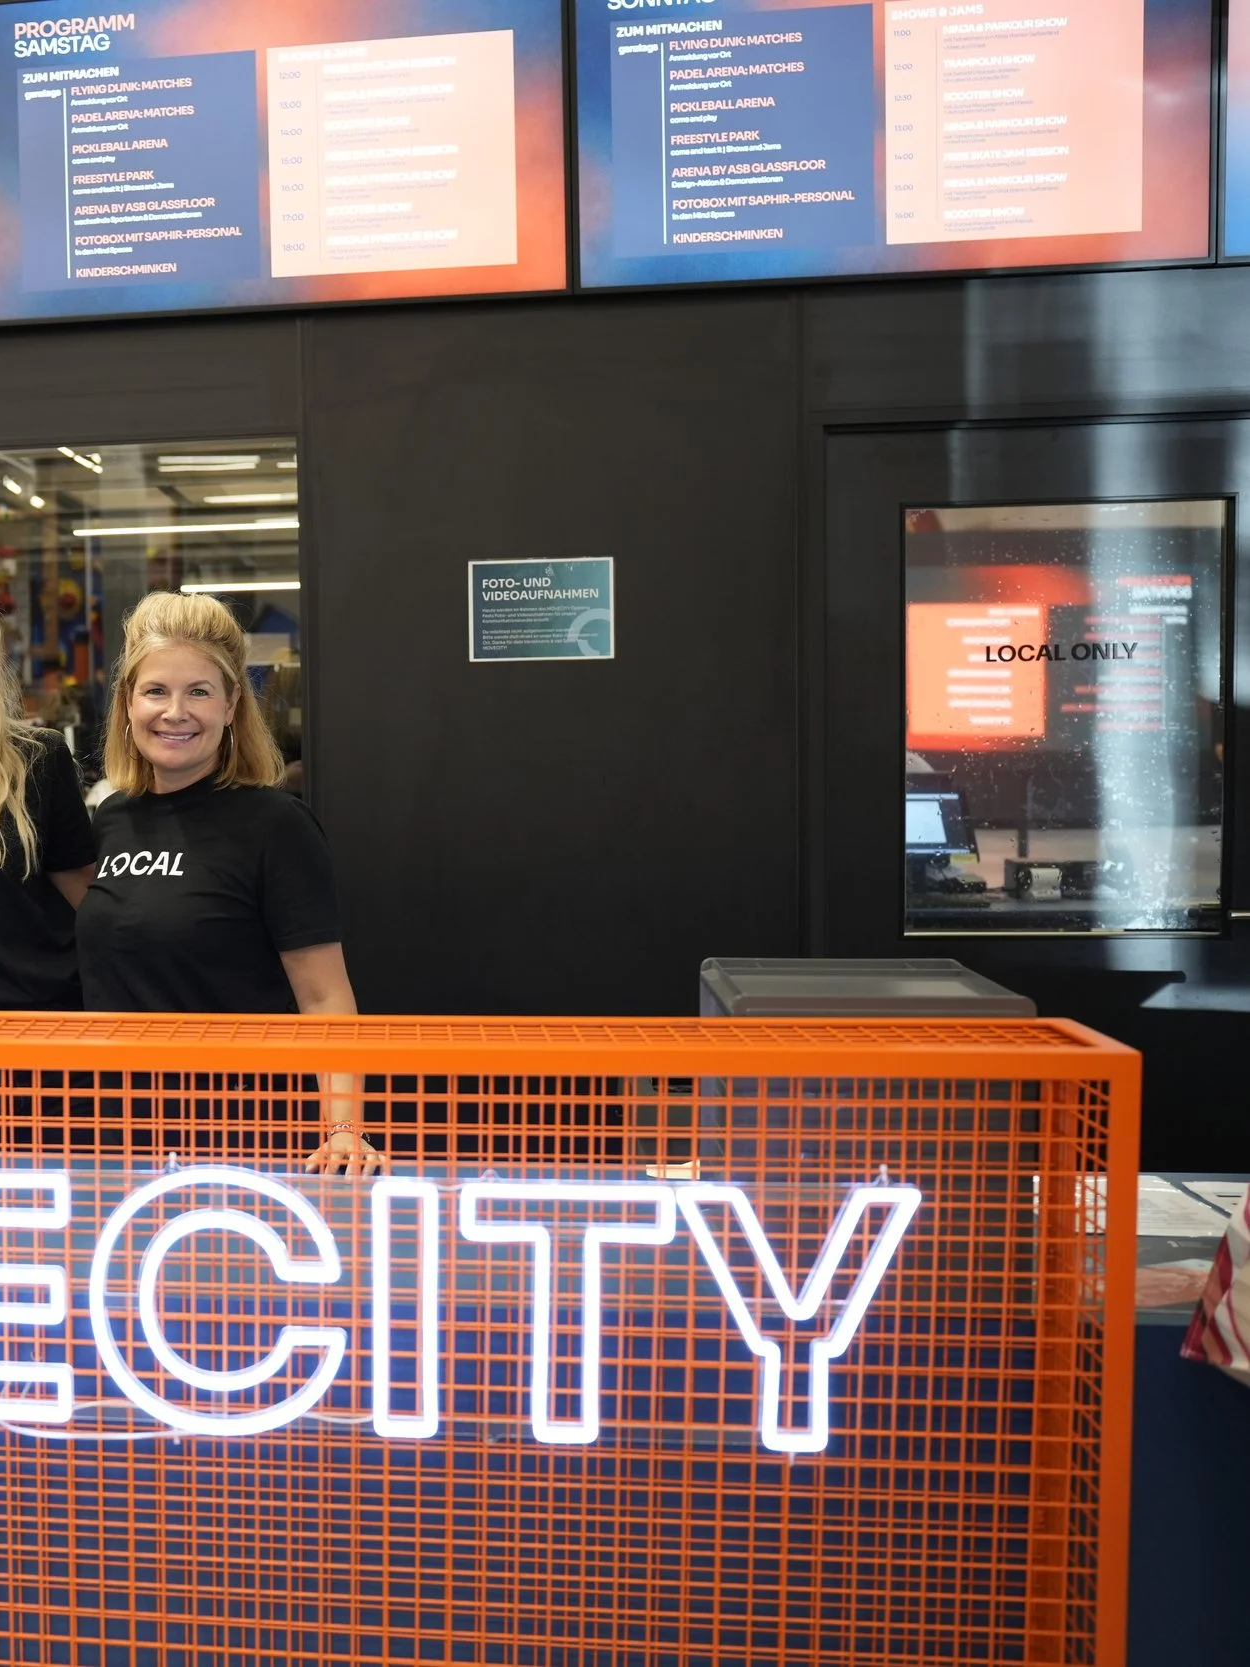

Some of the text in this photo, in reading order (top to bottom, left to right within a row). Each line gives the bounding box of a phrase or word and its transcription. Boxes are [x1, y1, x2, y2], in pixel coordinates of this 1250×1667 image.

[891, 8, 937, 21] SHOWS
[949, 4, 984, 16] JAMS
[14, 13, 135, 40] PROGRAMM
[616, 20, 722, 38] ZUM MITMACHEN
[984, 19, 1034, 32] PARKOUR
[1034, 17, 1068, 28] SHOW
[14, 33, 110, 58] SAMSTAG
[669, 32, 803, 51] FLYING DUNK: MATCHES
[1001, 54, 1035, 65] SHOW
[22, 66, 119, 84] ZUM MITMACHEN
[669, 61, 805, 81] PADEL ARENA: MATCHES
[71, 77, 193, 96] FLYING DUNK: MATCHES
[670, 96, 775, 113] PICKLEBALL ARENA
[71, 105, 194, 124] PADEL ARENA: MATCHES
[72, 138, 168, 155] PICKLEBALL ARENA
[671, 130, 760, 145] FREESTYLE PARK
[73, 170, 154, 185] FREESTYLE PARK
[672, 159, 826, 178] ARENA BY ASB GLASSFLOOR
[74, 197, 215, 216] ARENA BY ASB GLASSFLOOR
[672, 190, 855, 210] FOTOBOX MIT SAPHIR-PERSONAL
[75, 227, 242, 246] FOTOBOX MIT SAPHIR-PERSONAL
[673, 228, 783, 244] KINDERSCHMINKEN
[76, 262, 177, 278] KINDERSCHMINKEN
[482, 577, 551, 589] FOTO- UND
[482, 588, 599, 601] VIDEOAUFNAHMEN
[986, 642, 1138, 662] LOCAL ONLY
[97, 850, 184, 879] LOCAL
